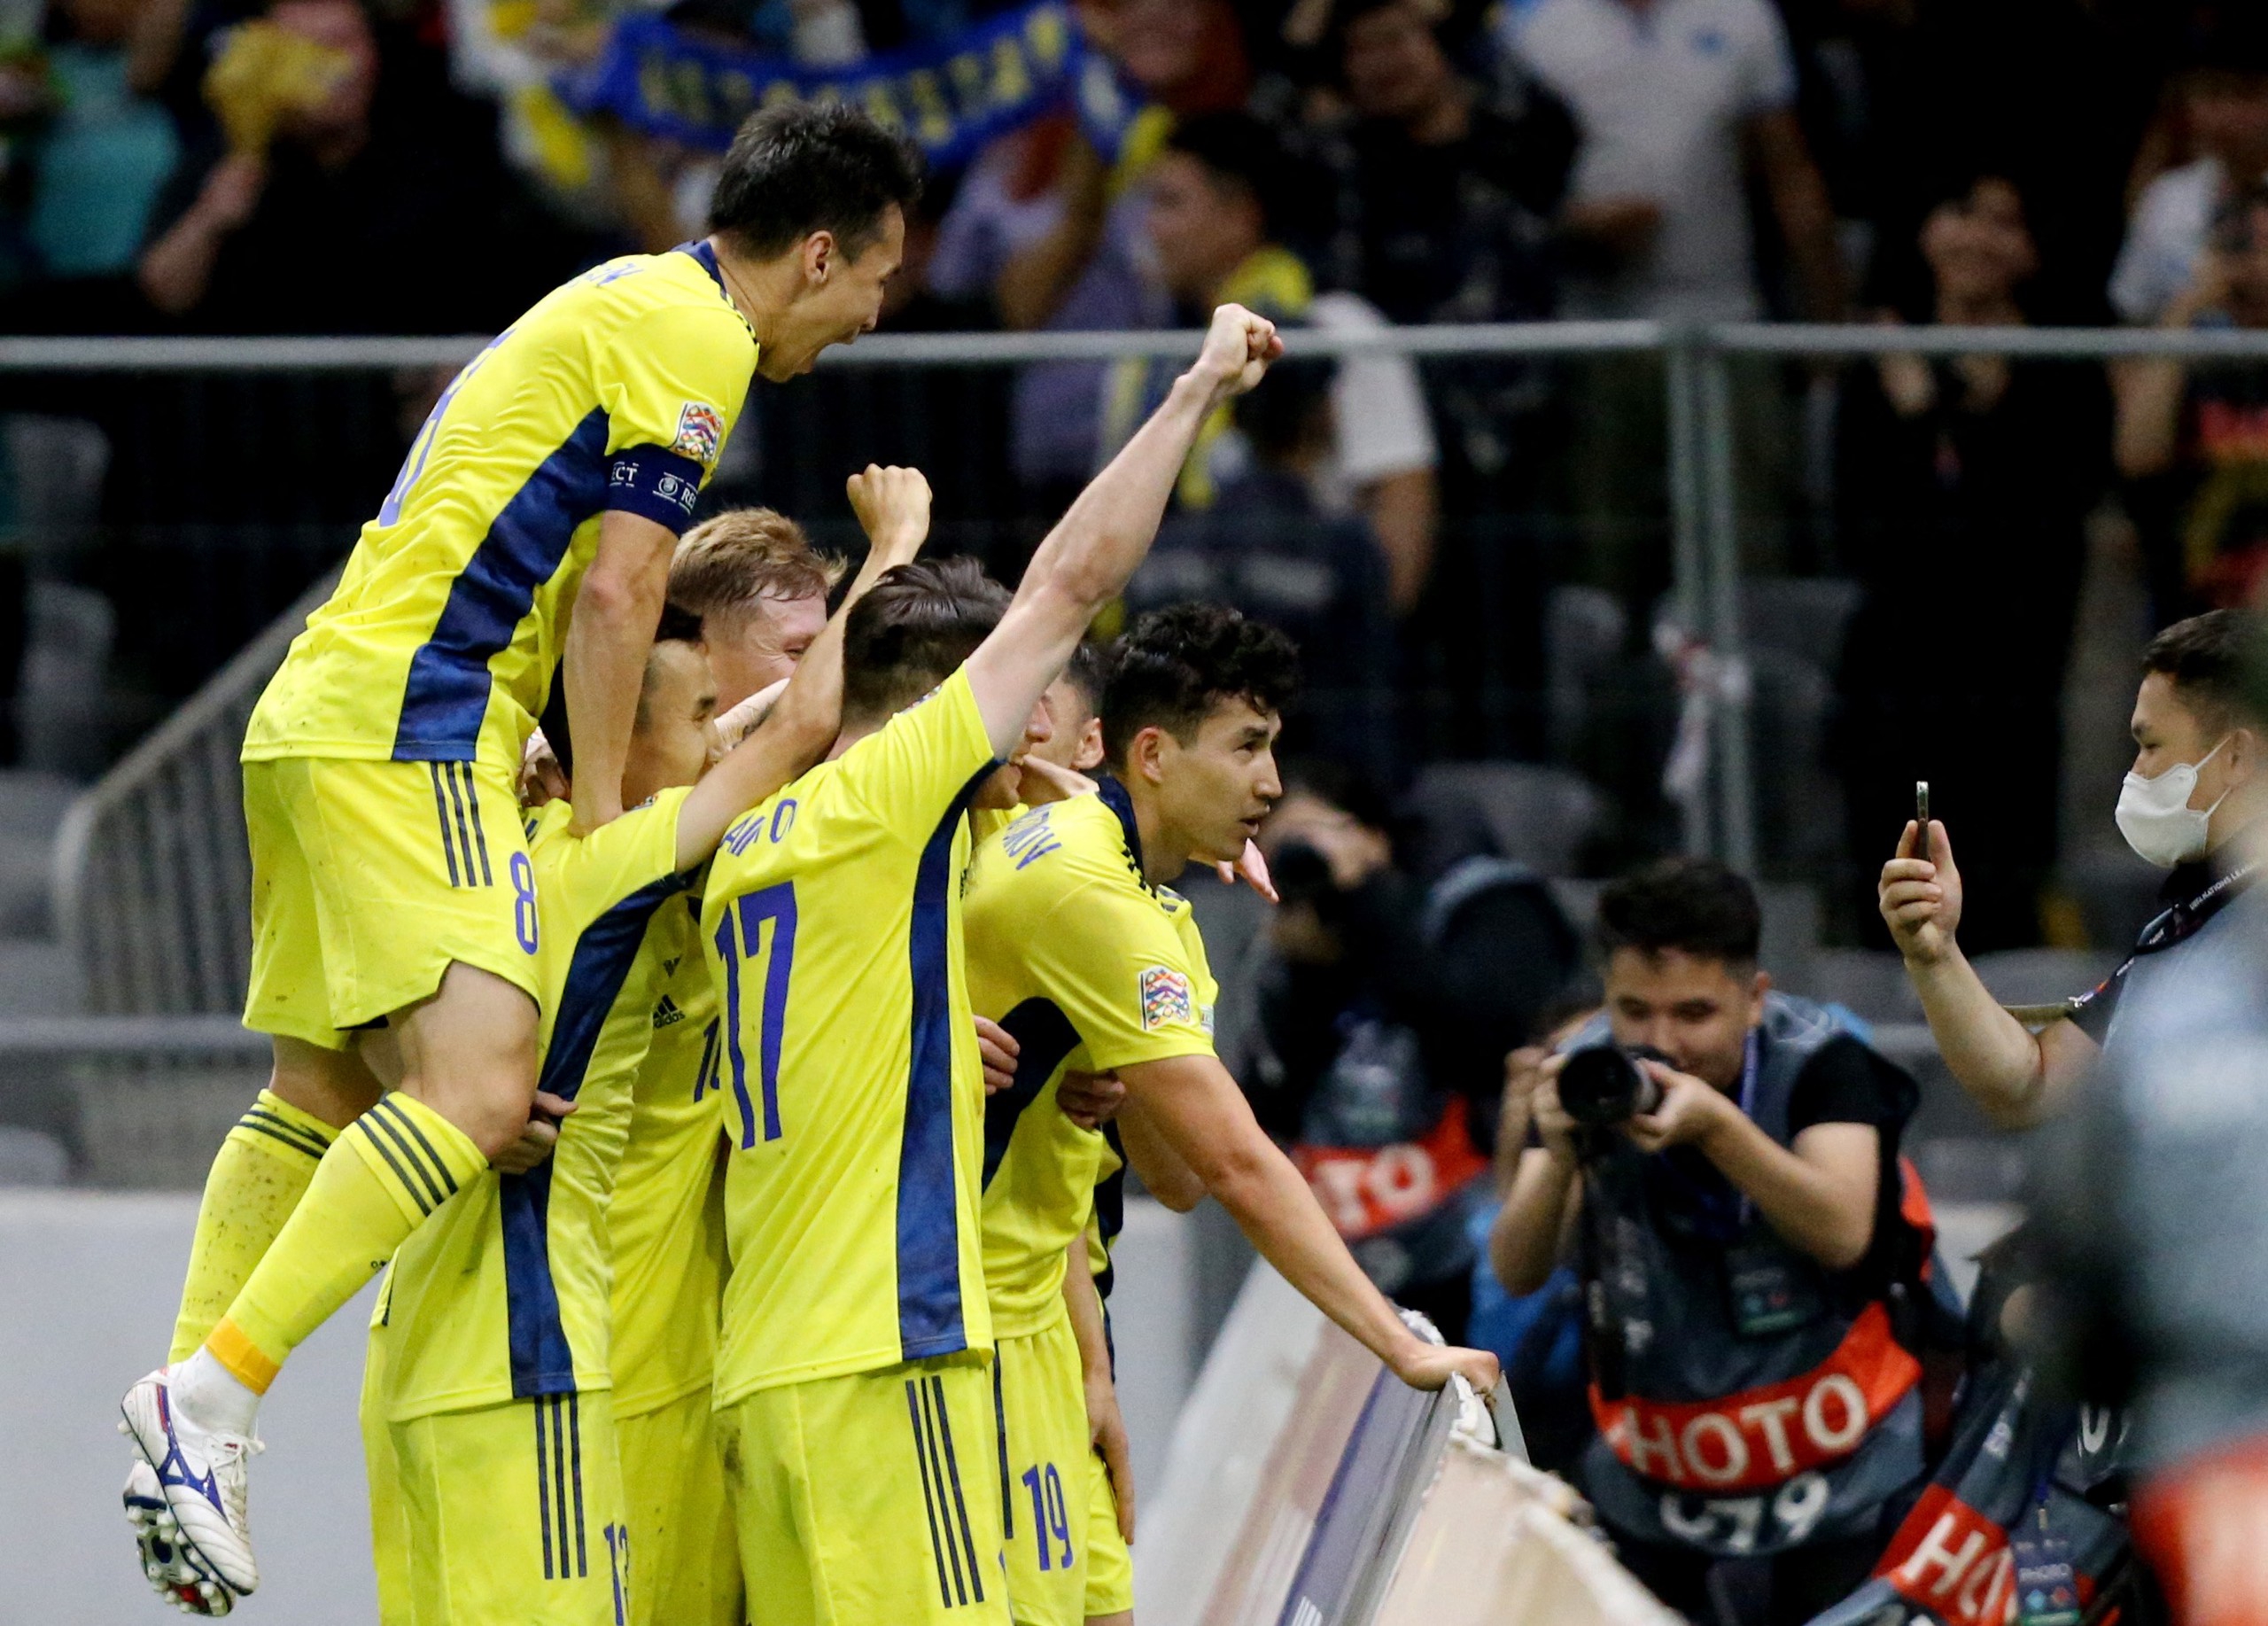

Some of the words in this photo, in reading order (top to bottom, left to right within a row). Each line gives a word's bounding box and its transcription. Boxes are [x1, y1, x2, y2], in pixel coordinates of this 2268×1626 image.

[509, 851, 538, 955] 8
[2202, 875, 2233, 900] NATIONS
[714, 880, 797, 1150] 17
[1605, 1373, 1867, 1482] HOTO
[1021, 1461, 1074, 1572] 19
